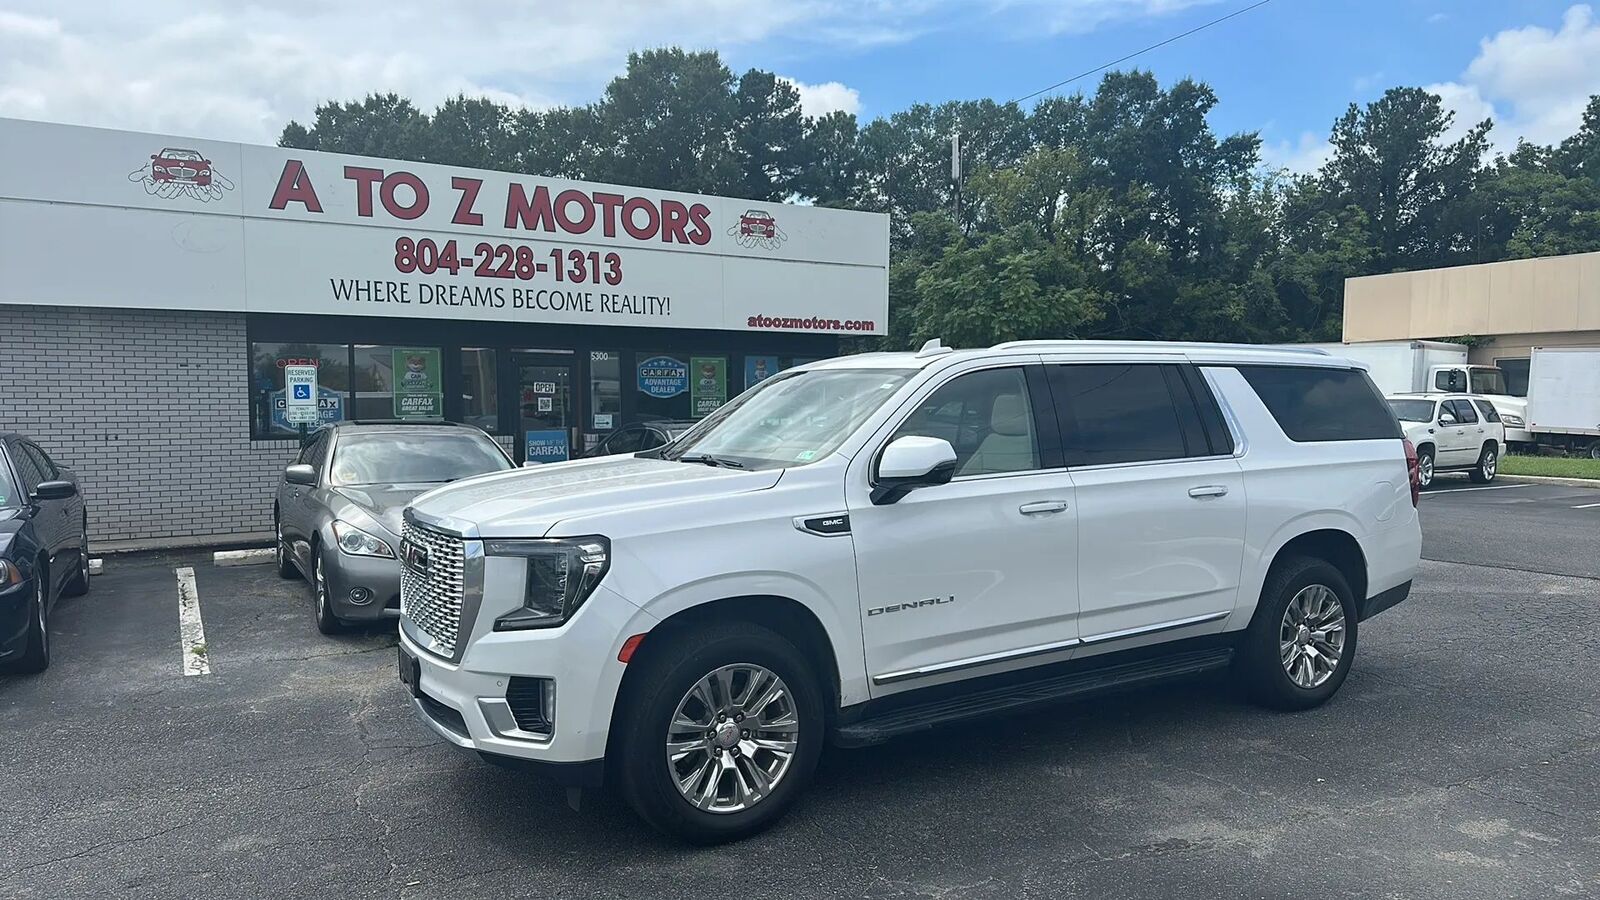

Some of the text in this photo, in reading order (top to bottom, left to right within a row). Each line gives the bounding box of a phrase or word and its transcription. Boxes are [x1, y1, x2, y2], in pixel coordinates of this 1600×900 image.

[268, 159, 712, 246] A TO Z MOTORS
[394, 236, 623, 286] 804-228-1313
[330, 278, 671, 316] WHERE DREAMS BECOME REALITY!
[747, 314, 875, 332] atoozmotors.com
[590, 352, 609, 361] 5300
[641, 369, 685, 378] CARFAX
[535, 383, 554, 393] OPEN
[401, 397, 433, 406] CARFAX
[529, 446, 565, 456] CARFAX
[822, 518, 843, 526] GMC
[867, 594, 955, 616] DENALI
